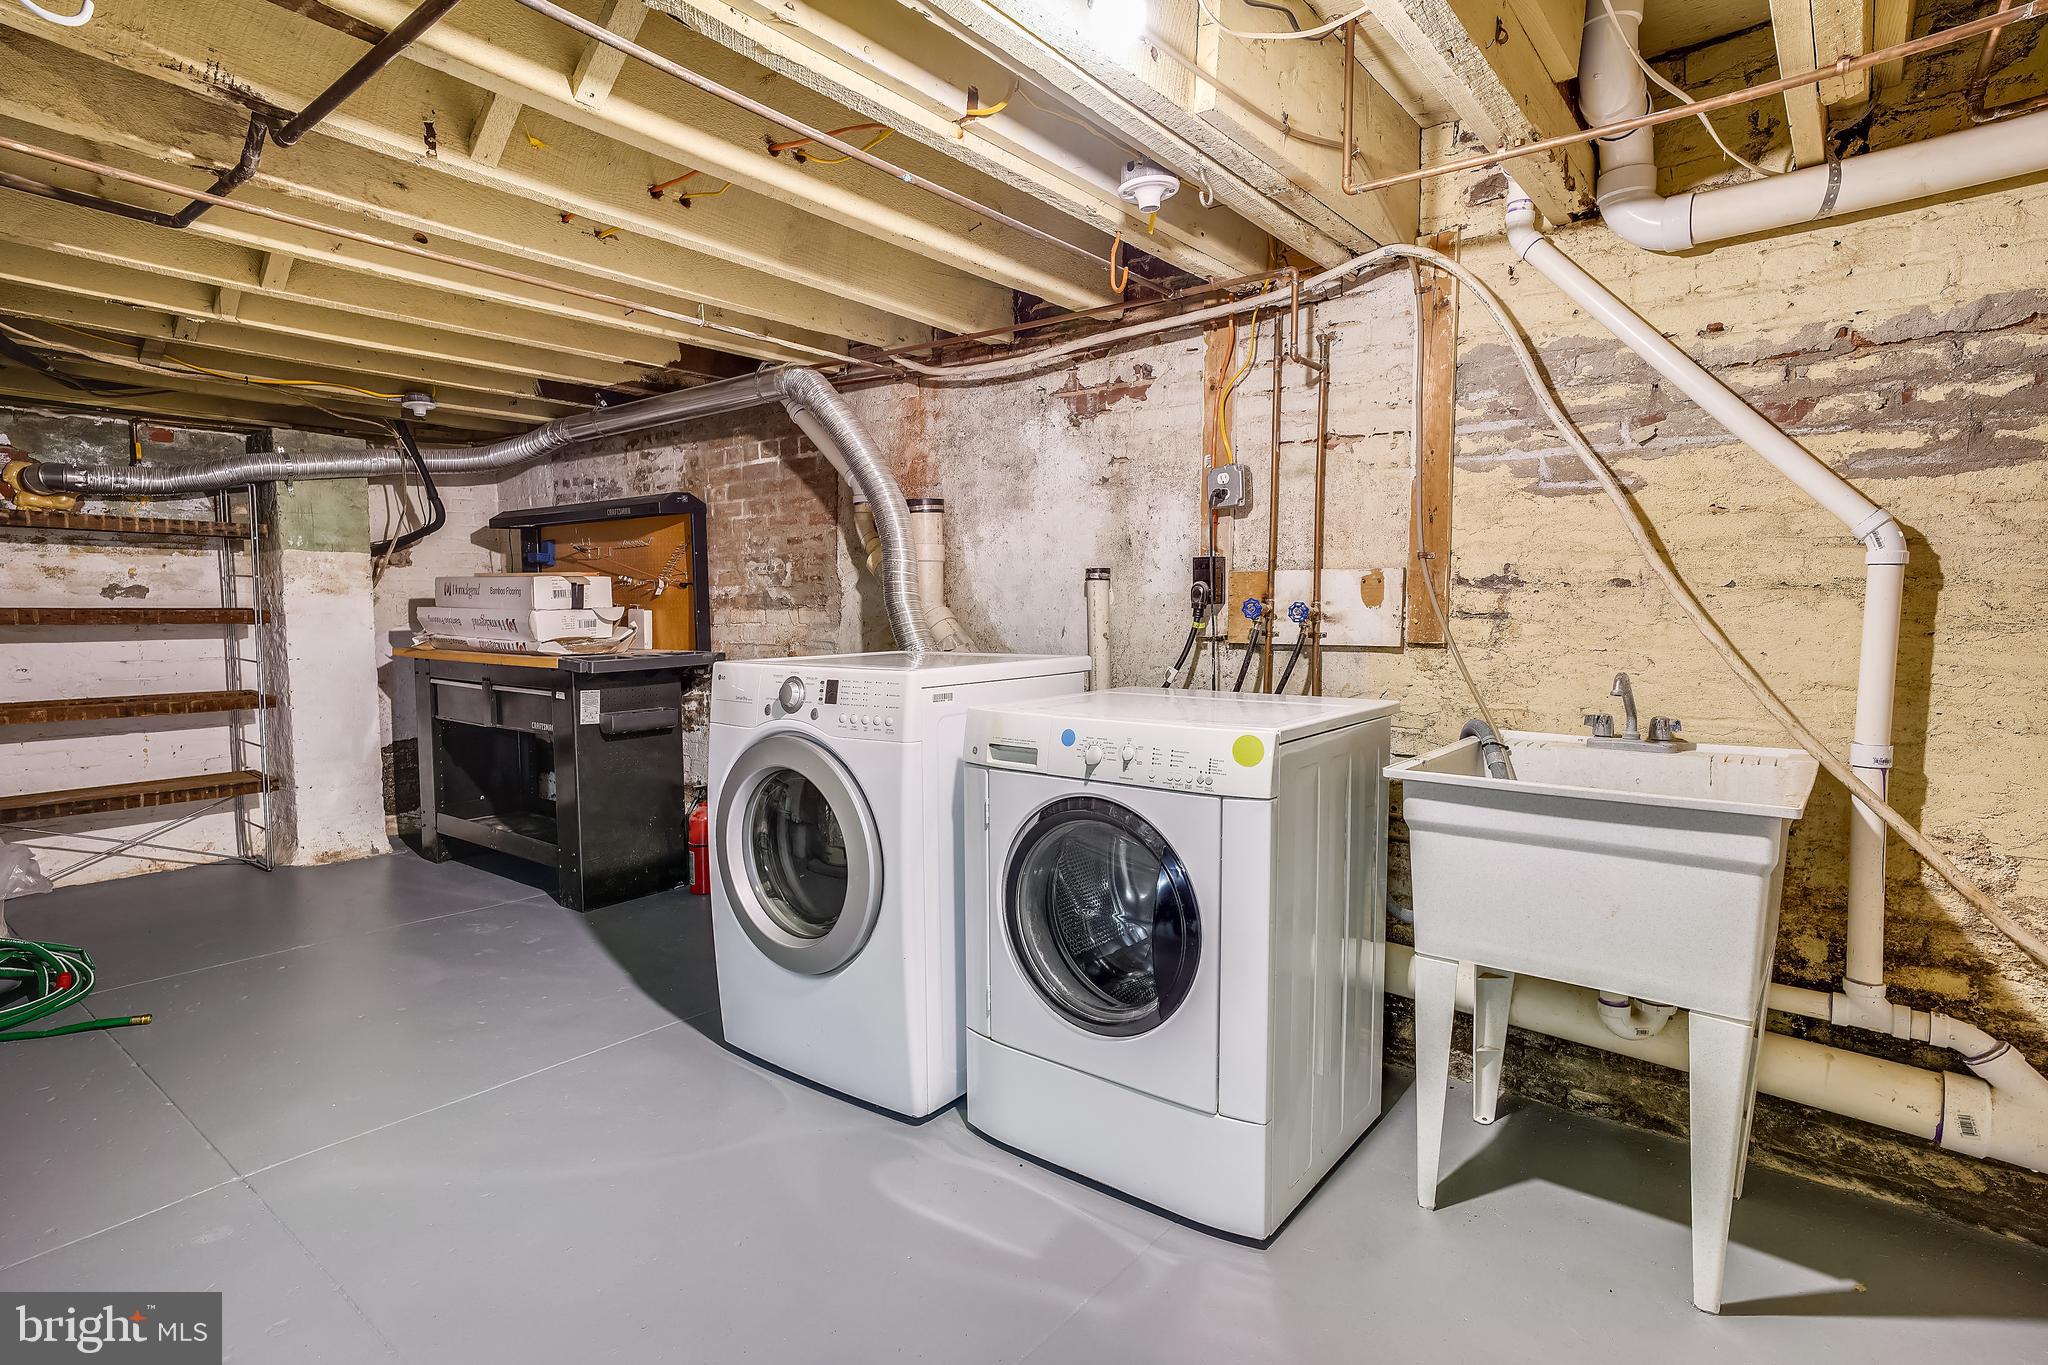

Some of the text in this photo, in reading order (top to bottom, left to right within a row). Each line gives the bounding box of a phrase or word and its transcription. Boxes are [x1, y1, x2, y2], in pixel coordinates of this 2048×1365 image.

[606, 507, 631, 516] CRAFTSMAN
[490, 586, 521, 597] Bamboo Flooring
